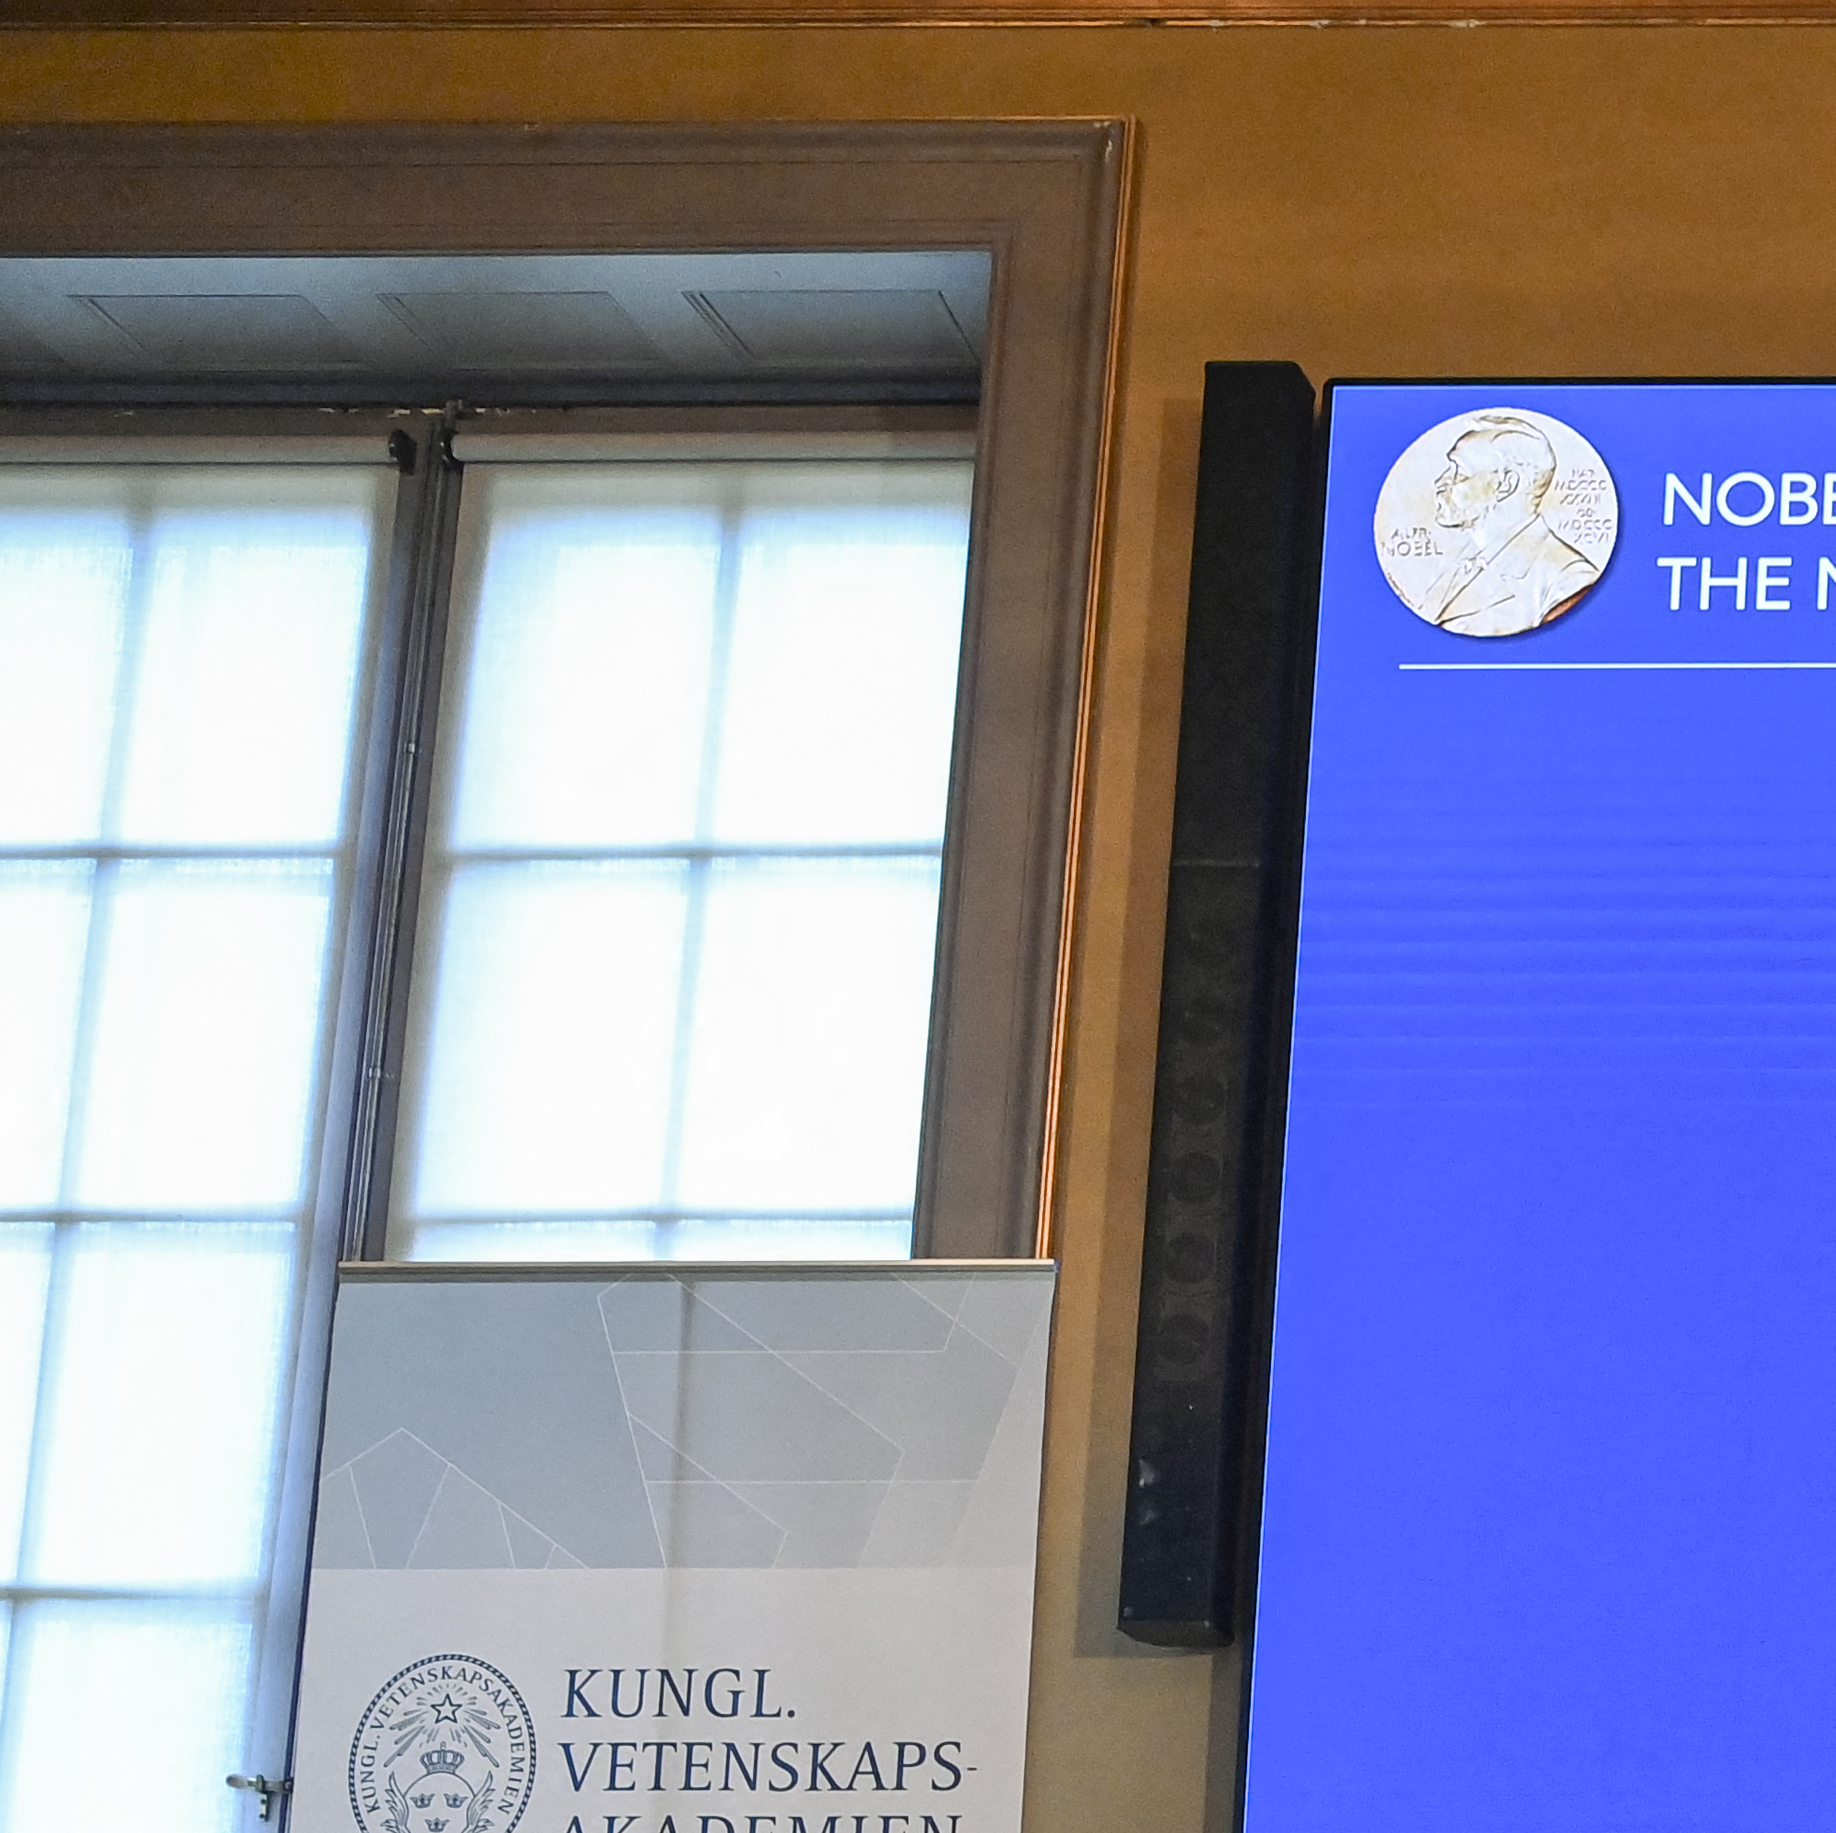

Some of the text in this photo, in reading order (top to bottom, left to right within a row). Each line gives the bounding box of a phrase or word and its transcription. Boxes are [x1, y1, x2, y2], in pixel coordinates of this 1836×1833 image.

[1657, 557, 1792, 610] THE
[561, 1668, 796, 1718] KUNGL.
[360, 1666, 526, 1814] KUNGL. VETENSKAPSAKADEMIEN
[557, 1741, 978, 1792] VETENSKAPS-
